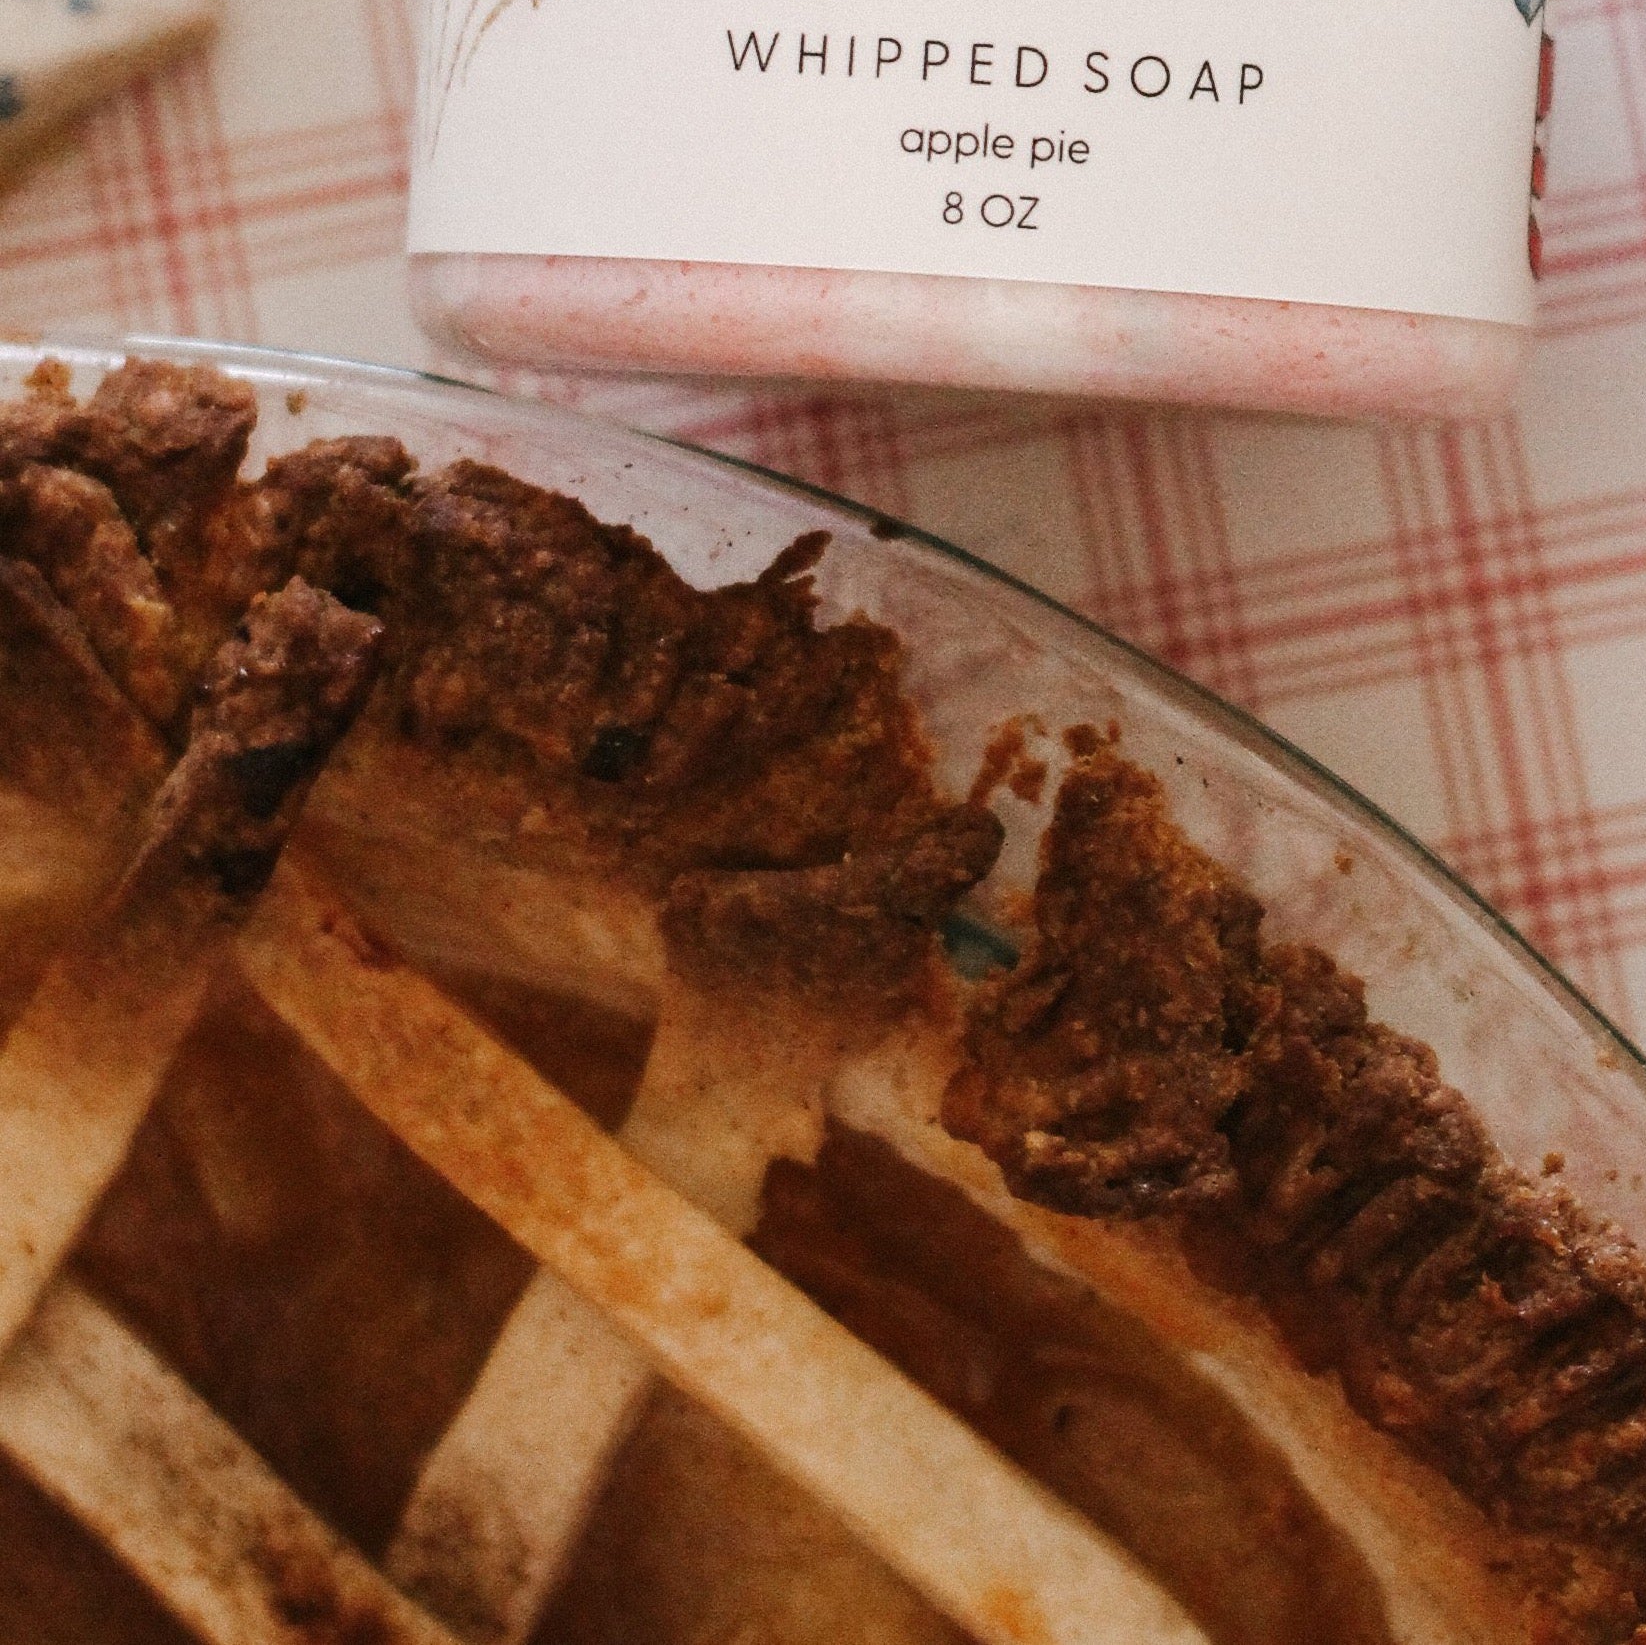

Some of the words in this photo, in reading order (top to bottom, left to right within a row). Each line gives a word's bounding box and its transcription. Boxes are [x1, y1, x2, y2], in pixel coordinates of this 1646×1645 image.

[726, 29, 1048, 88] WHIPPED
[1083, 51, 1265, 105] SOAP
[900, 123, 1015, 165] apple
[1030, 130, 1090, 169] pie
[942, 191, 964, 225] 8
[980, 194, 1040, 230] OZ
